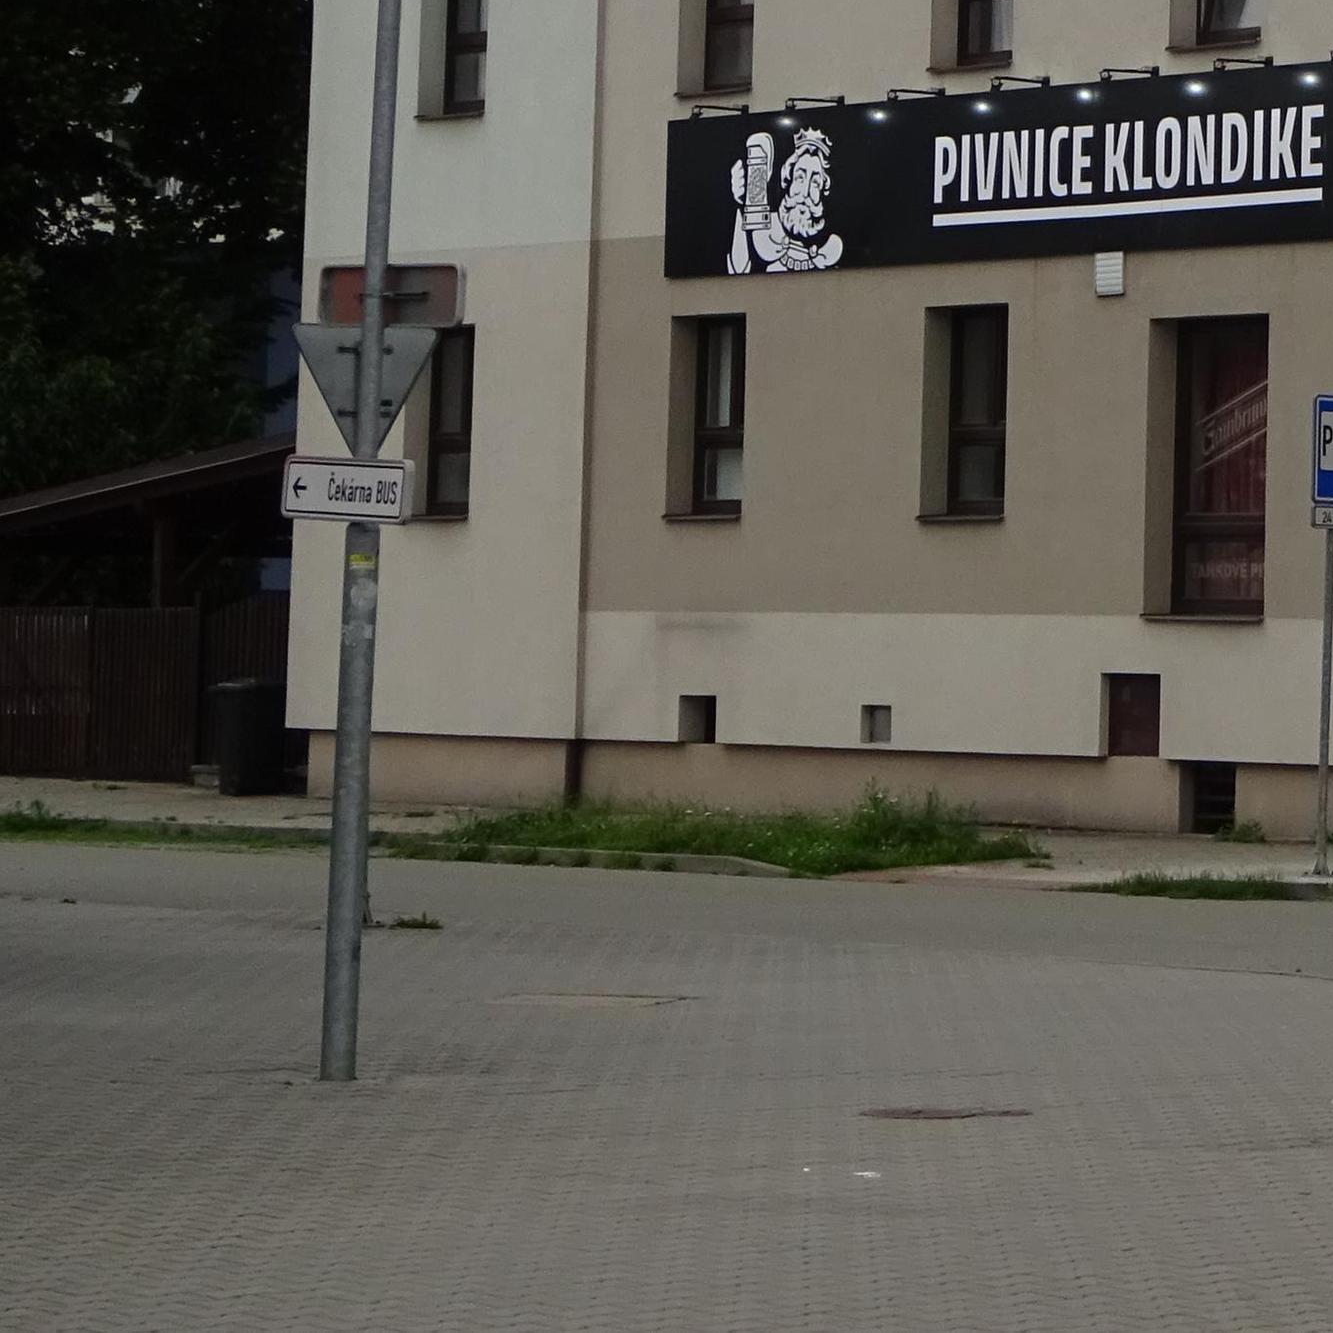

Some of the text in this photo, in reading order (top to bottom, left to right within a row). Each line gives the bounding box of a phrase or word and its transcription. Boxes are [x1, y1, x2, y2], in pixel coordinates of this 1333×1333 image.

[933, 104, 1325, 203] PIVNICE KLONDIKE
[327, 471, 398, 505] Čekárna BUS
[1322, 511, 1333, 524] 24
